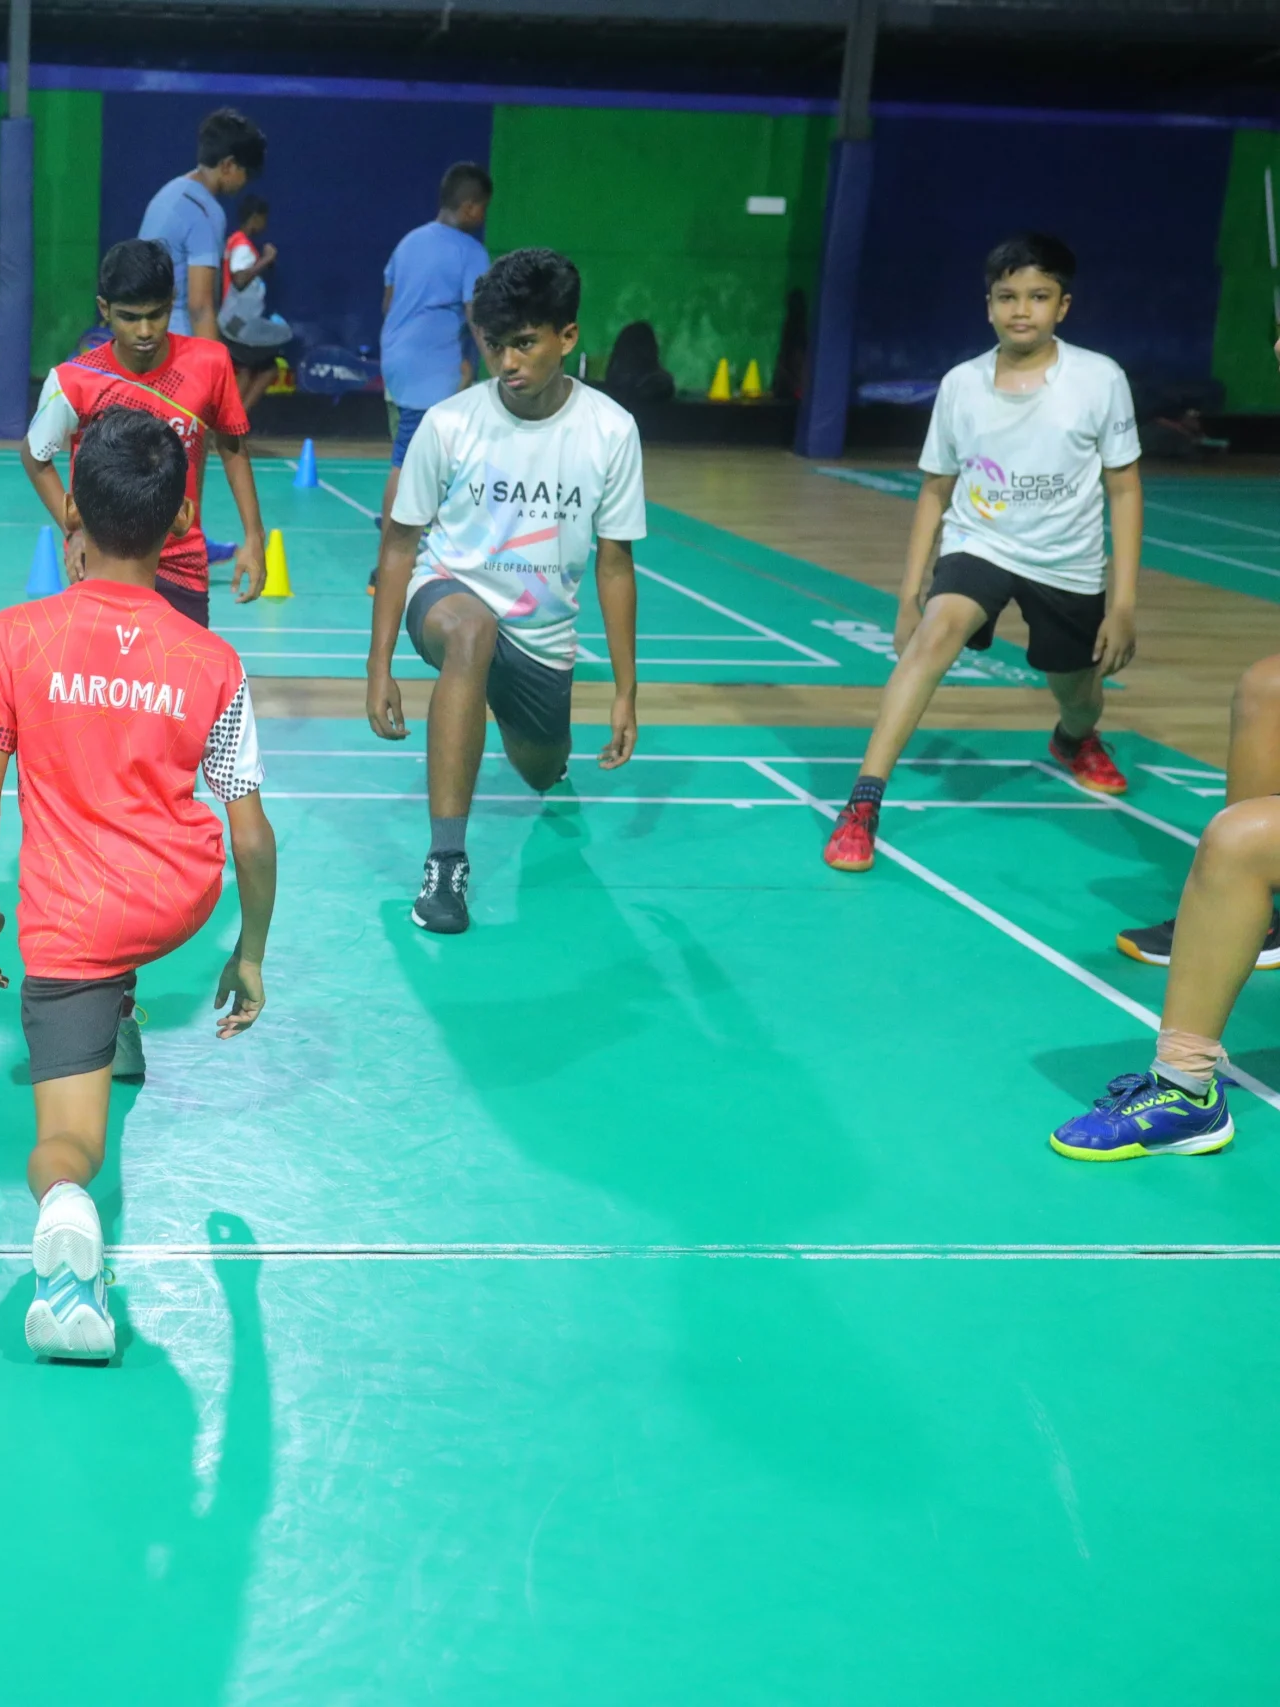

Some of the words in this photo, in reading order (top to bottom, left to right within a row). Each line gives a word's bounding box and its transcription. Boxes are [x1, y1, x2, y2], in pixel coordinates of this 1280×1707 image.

[1011, 470, 1065, 488] toss
[492, 480, 582, 508] SAAA
[483, 560, 502, 571] LIFE
[503, 561, 514, 573] OF
[48, 671, 187, 721] AAROMAL
